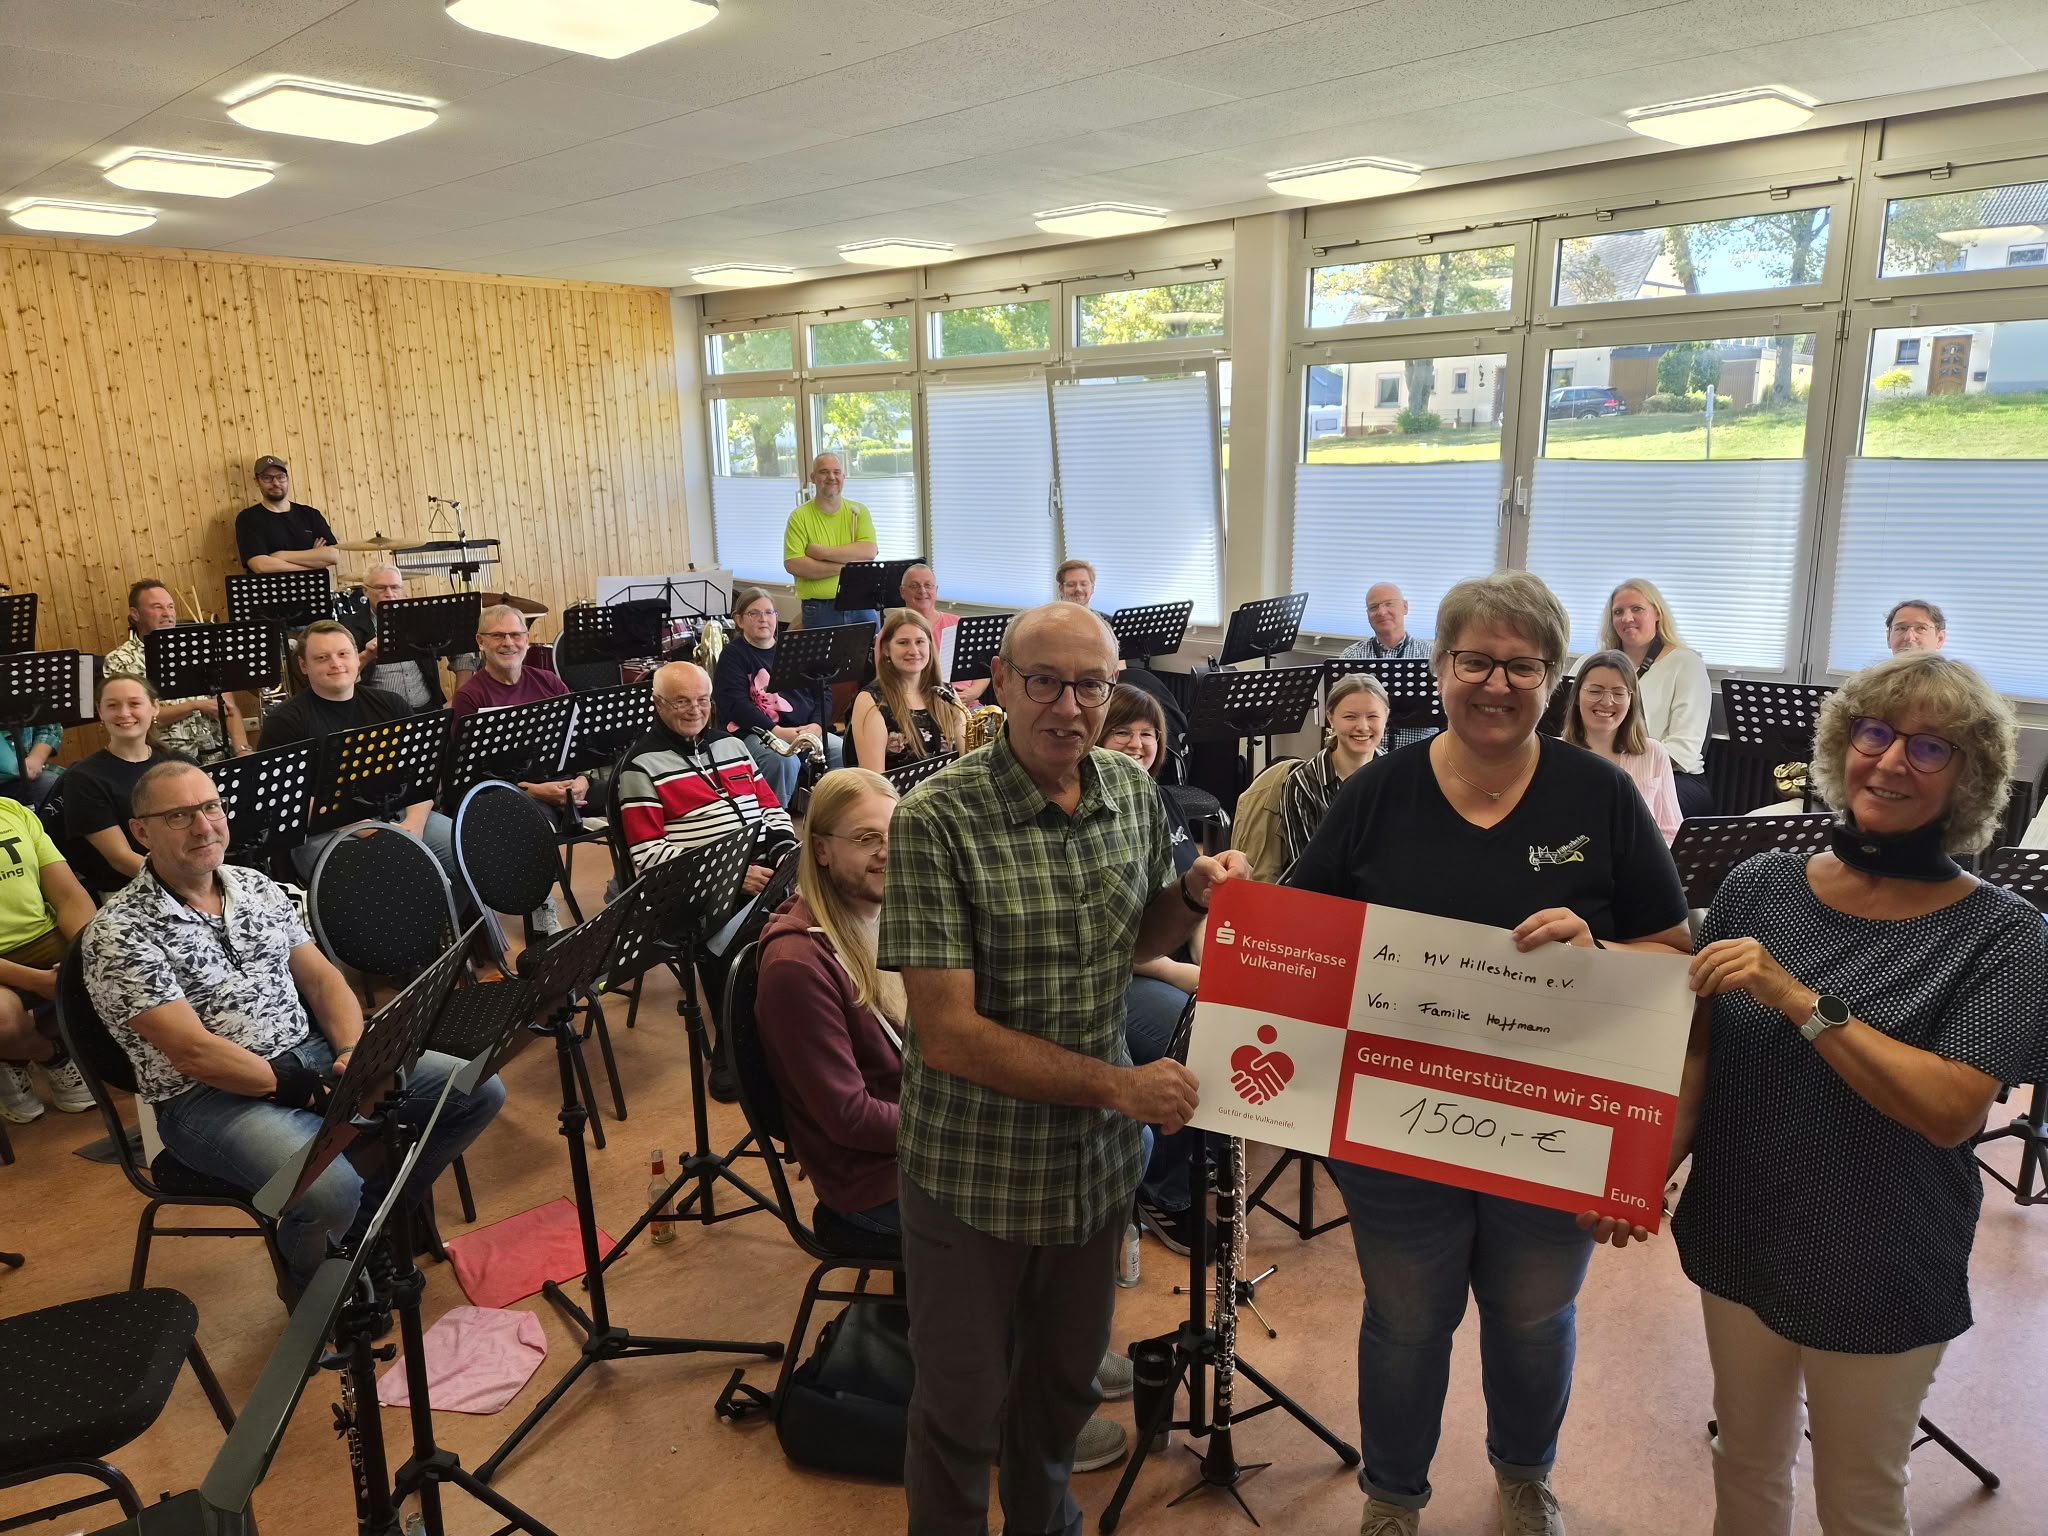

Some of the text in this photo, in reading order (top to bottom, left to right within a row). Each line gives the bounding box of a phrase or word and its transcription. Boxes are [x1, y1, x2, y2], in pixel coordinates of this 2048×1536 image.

[0, 867, 25, 881] ing
[1240, 952, 1317, 979] Vulkaneifel
[1242, 935, 1347, 968] Kreissparkasse
[1373, 944, 1574, 989] An: MV Hillesheim e.V.
[1367, 992, 1397, 1011] Von:
[1418, 1002, 1471, 1021] Familie
[1357, 1046, 1662, 1126] Gerne unterstützen wir Sie mit
[1218, 1106, 1295, 1129] Gut für die Vulkaneifel.
[1610, 1187, 1650, 1211] Euro.
